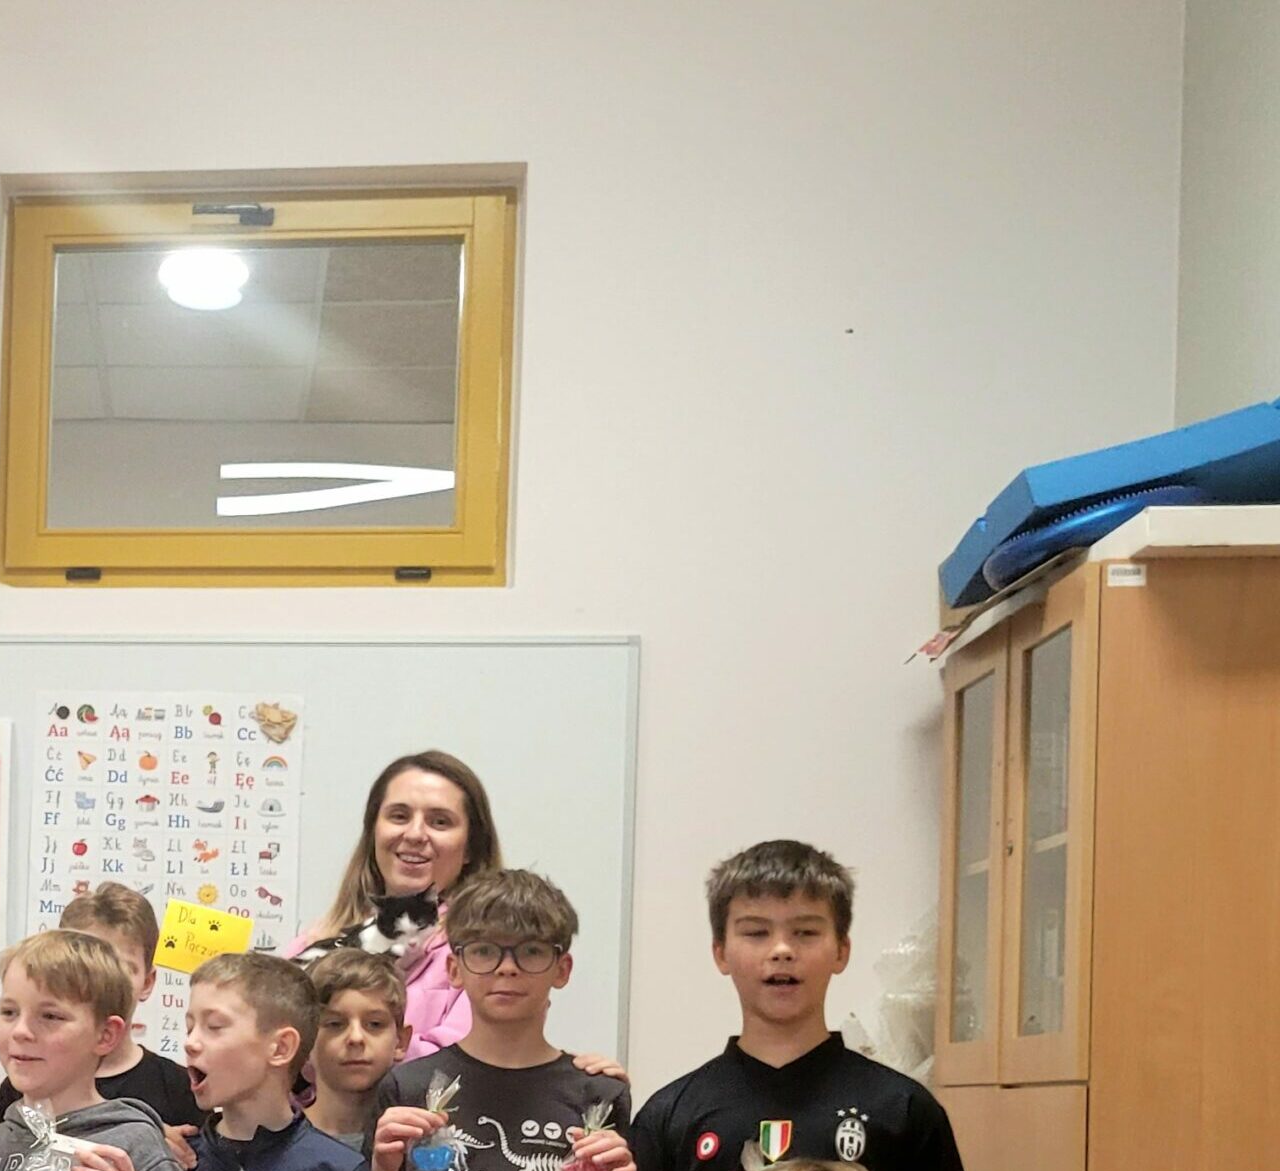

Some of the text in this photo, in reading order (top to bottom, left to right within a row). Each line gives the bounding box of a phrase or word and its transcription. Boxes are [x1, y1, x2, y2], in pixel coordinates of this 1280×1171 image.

[48, 724, 68, 736] Aa
[110, 725, 130, 741] Ąą
[174, 726, 193, 739] Bb
[237, 727, 257, 741] Cc
[161, 994, 183, 1008] Uu
